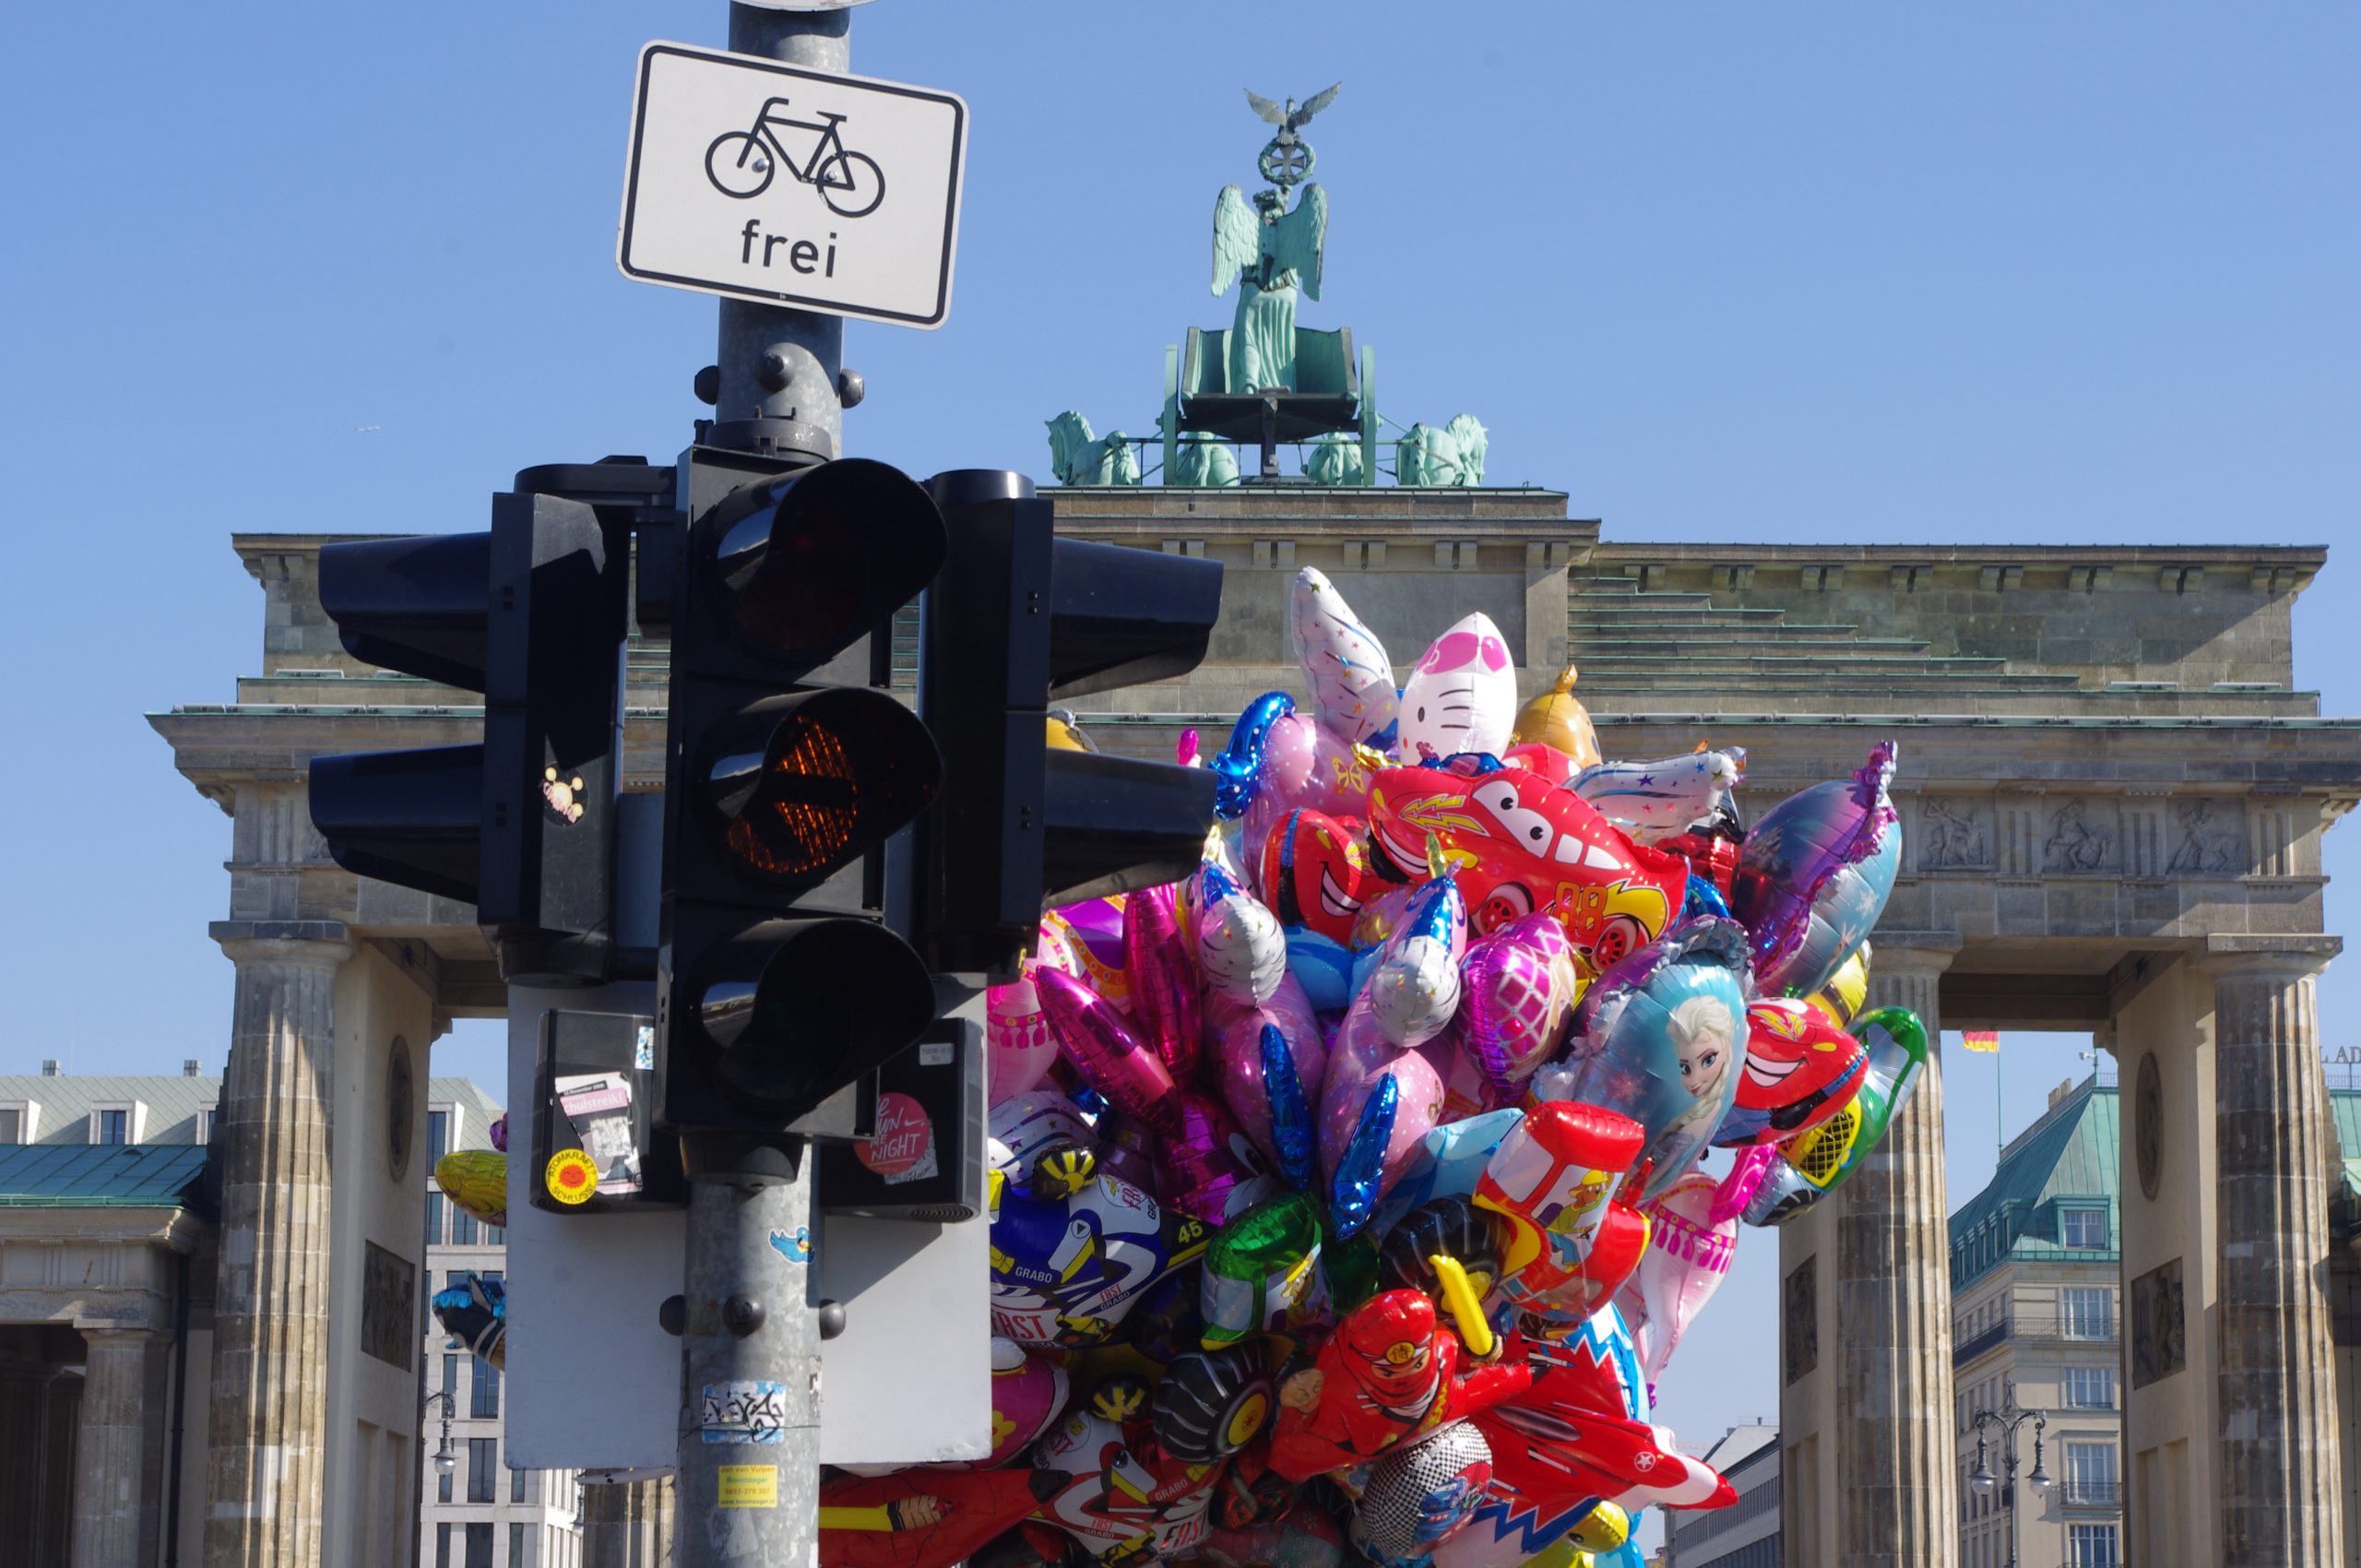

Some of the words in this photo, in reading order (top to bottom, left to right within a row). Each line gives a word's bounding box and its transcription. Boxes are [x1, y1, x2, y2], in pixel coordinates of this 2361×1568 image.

[742, 219, 837, 279] frei
[1555, 880, 1608, 938] 88
[2334, 1045, 2361, 1063] AD
[564, 1091, 623, 1112] chulstreik!
[877, 1107, 905, 1136] UN
[871, 1133, 921, 1162] NIGHT
[1178, 1219, 1204, 1244] 45
[1015, 1266, 1053, 1284] GRABO
[1099, 1283, 1122, 1302] FAST
[1100, 1291, 1131, 1312] GRABO
[1156, 1479, 1189, 1502] GRABO
[1085, 1527, 1115, 1539] GRABO
[1091, 1518, 1114, 1532] FAST
[1160, 1503, 1208, 1550] FAST
